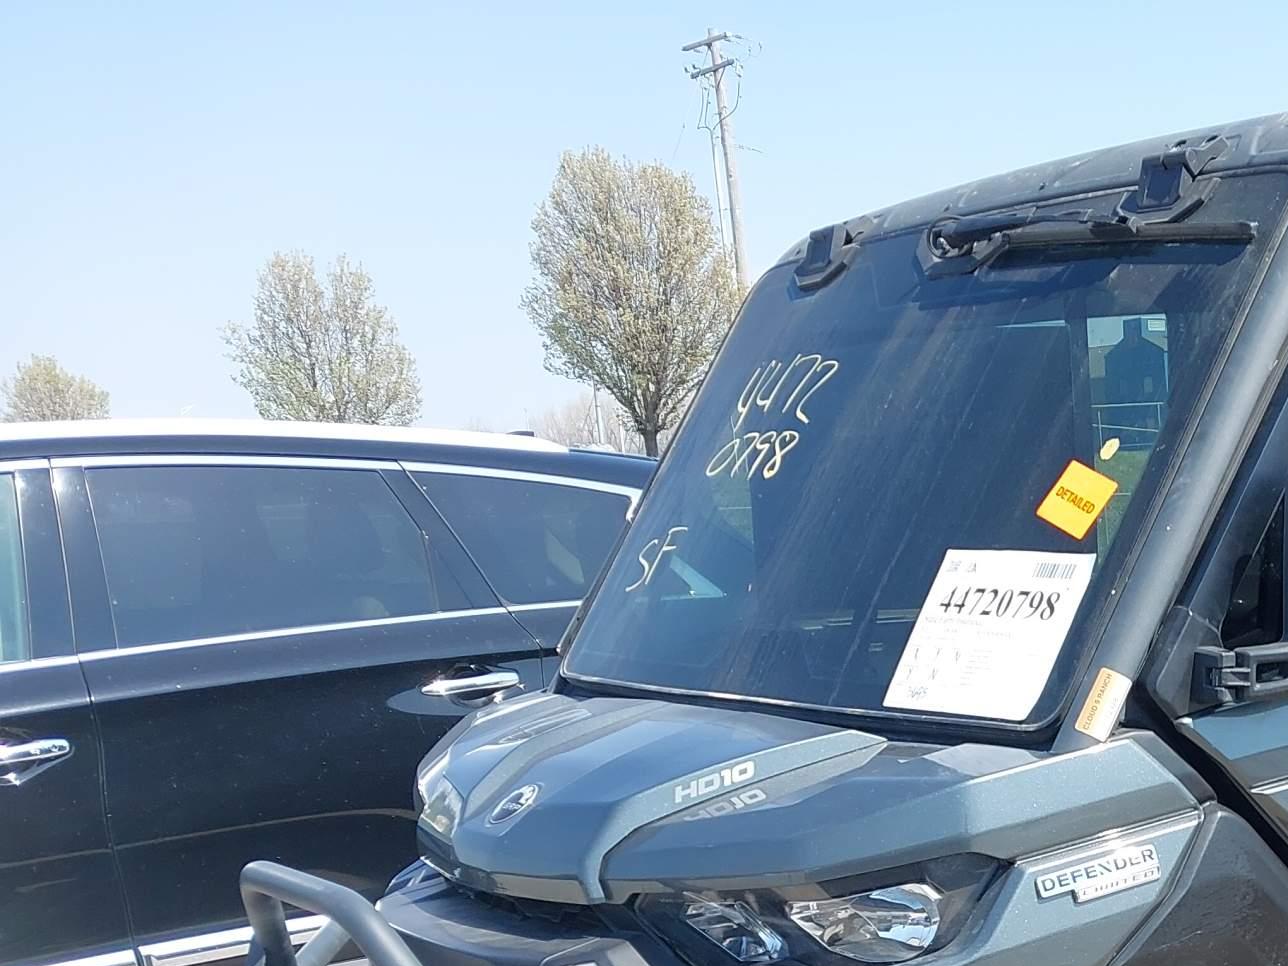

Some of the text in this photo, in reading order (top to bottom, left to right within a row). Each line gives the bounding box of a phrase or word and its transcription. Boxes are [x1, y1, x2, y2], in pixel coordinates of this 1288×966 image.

[737, 353, 839, 433] 4472
[705, 430, 800, 480] 0798
[1056, 486, 1096, 514] DETAILED
[625, 526, 688, 592] SF
[939, 586, 1061, 621] 44720798
[1083, 704, 1098, 730] CLOUD
[1098, 673, 1113, 700] RANCH
[674, 760, 755, 803] HD10
[1040, 848, 1155, 893] DEFENDER
